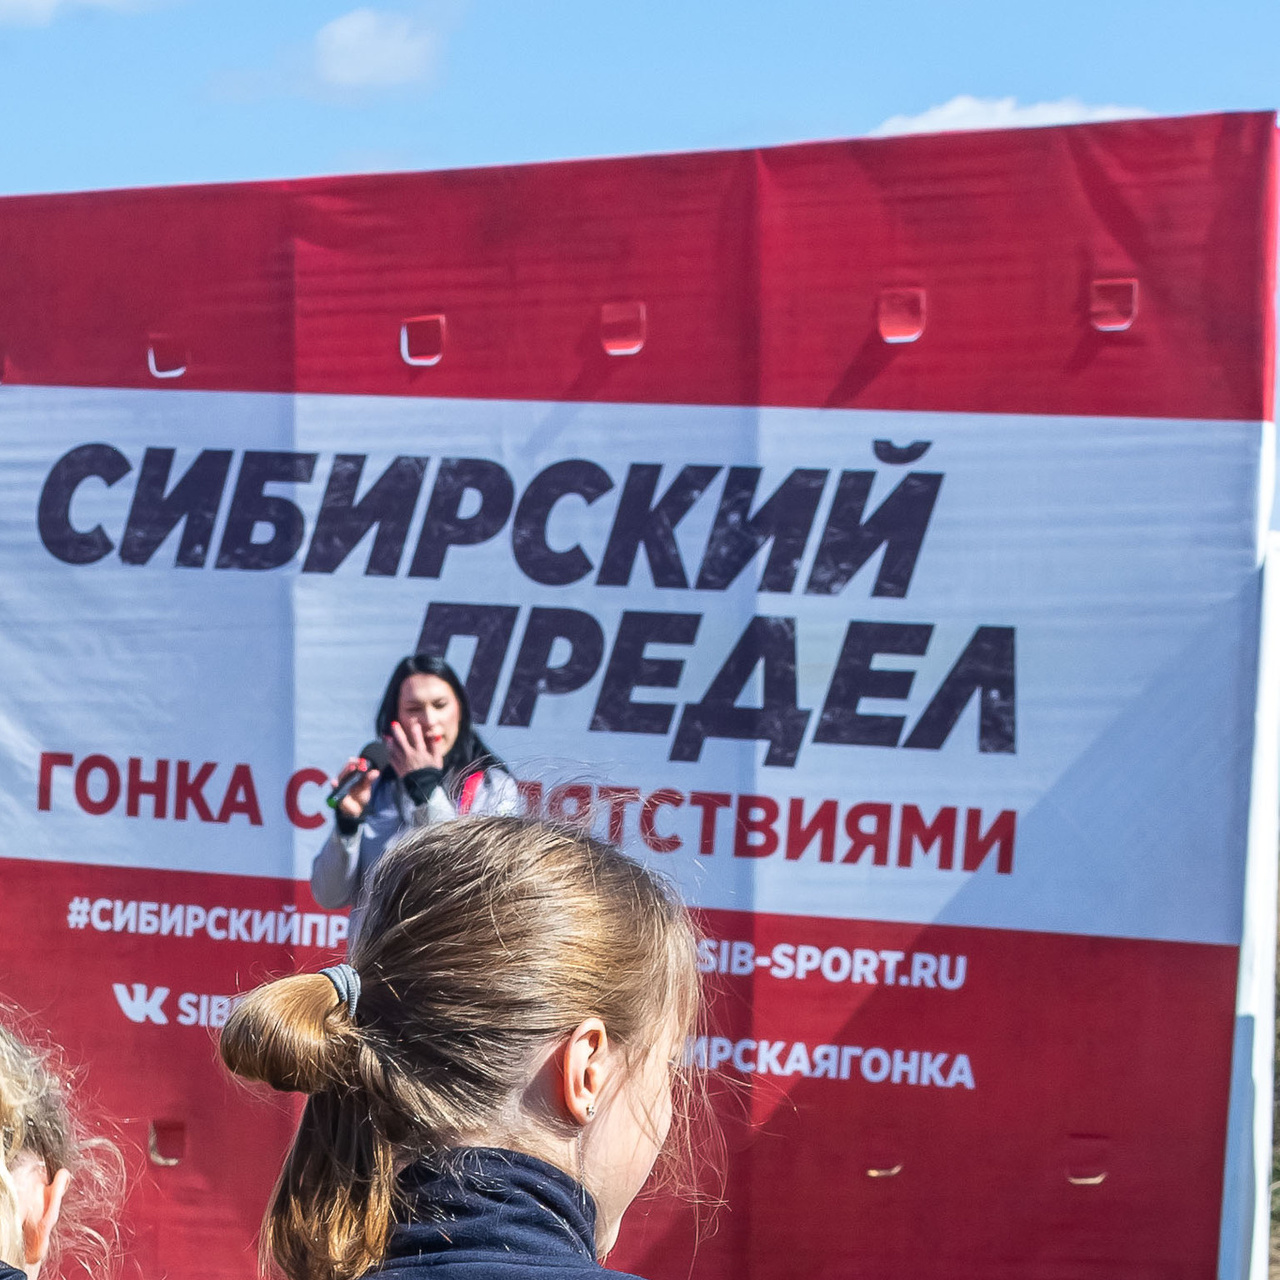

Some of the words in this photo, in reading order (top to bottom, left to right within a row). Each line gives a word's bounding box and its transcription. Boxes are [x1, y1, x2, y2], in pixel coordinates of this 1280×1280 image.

[37, 438, 944, 599] СИБИРСКИЙ
[415, 602, 1018, 768] ПРЕДЕЛ
[38, 752, 264, 827] ГОНКА
[285, 767, 328, 829] С
[68, 896, 349, 949] #СИБИРСКИЙПР
[696, 938, 967, 990] SIB-SPORT.RU
[176, 992, 236, 1028] SIB
[683, 1034, 975, 1090] ИРСКАЯГОНКА
